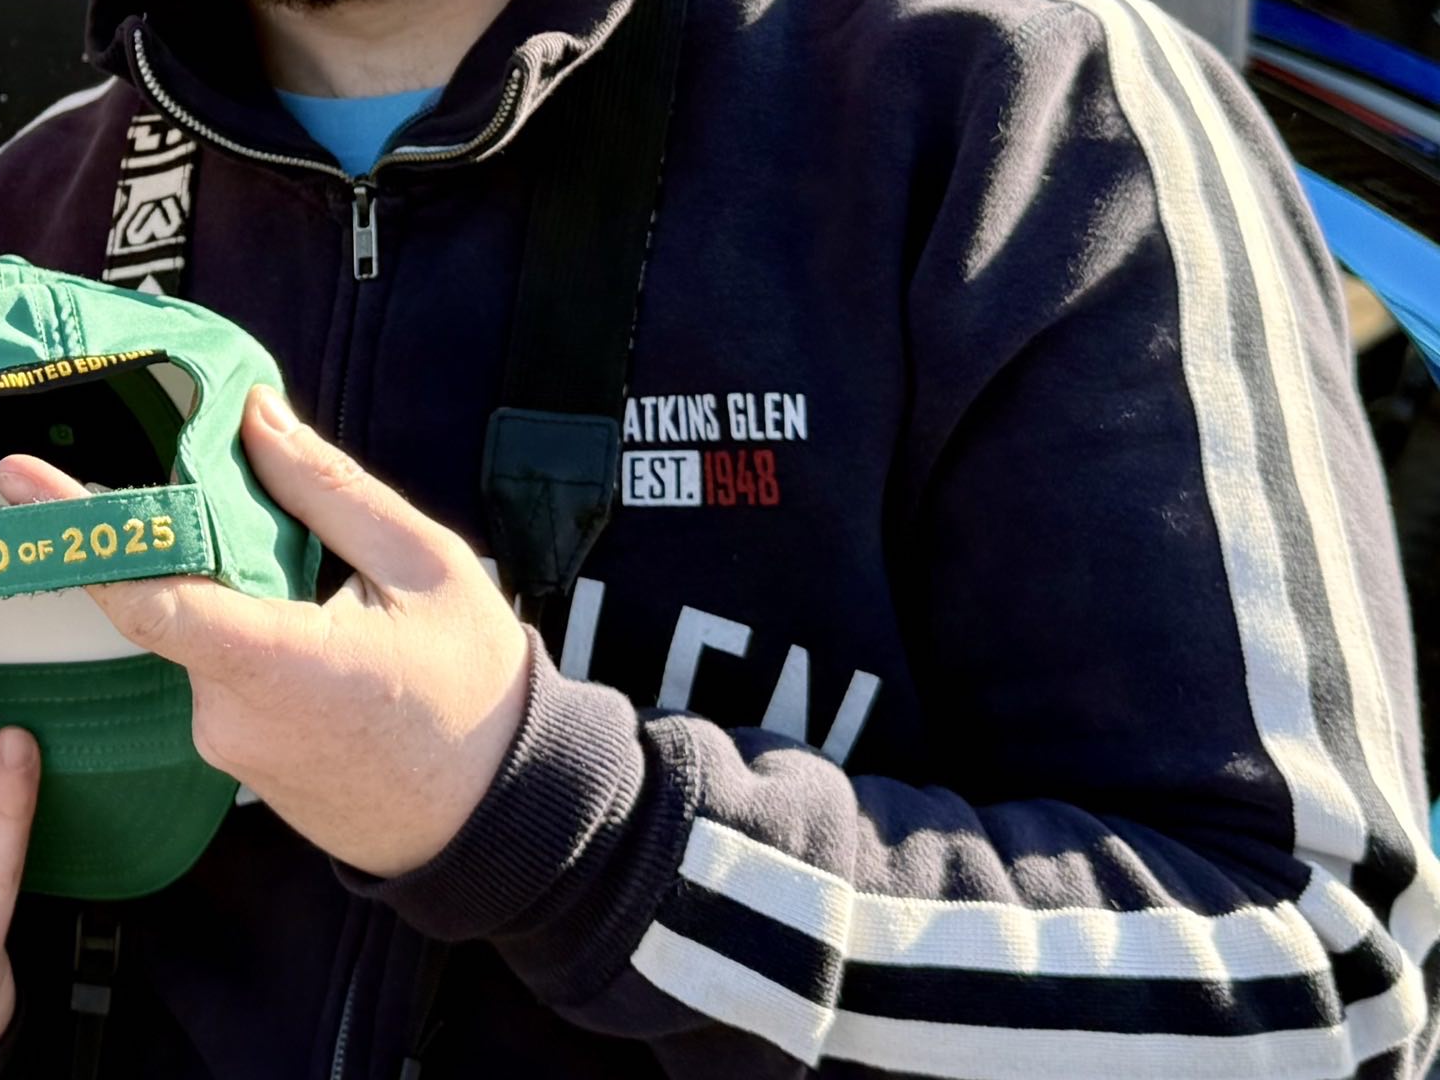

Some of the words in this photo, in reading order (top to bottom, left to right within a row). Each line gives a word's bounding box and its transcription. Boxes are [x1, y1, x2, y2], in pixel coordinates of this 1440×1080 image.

[623, 393, 721, 442] ATKINS
[726, 392, 808, 441] GLEN
[630, 456, 694, 500] EST.
[704, 449, 780, 506] 1948
[17, 539, 54, 563] OF
[62, 514, 175, 564] 2025
